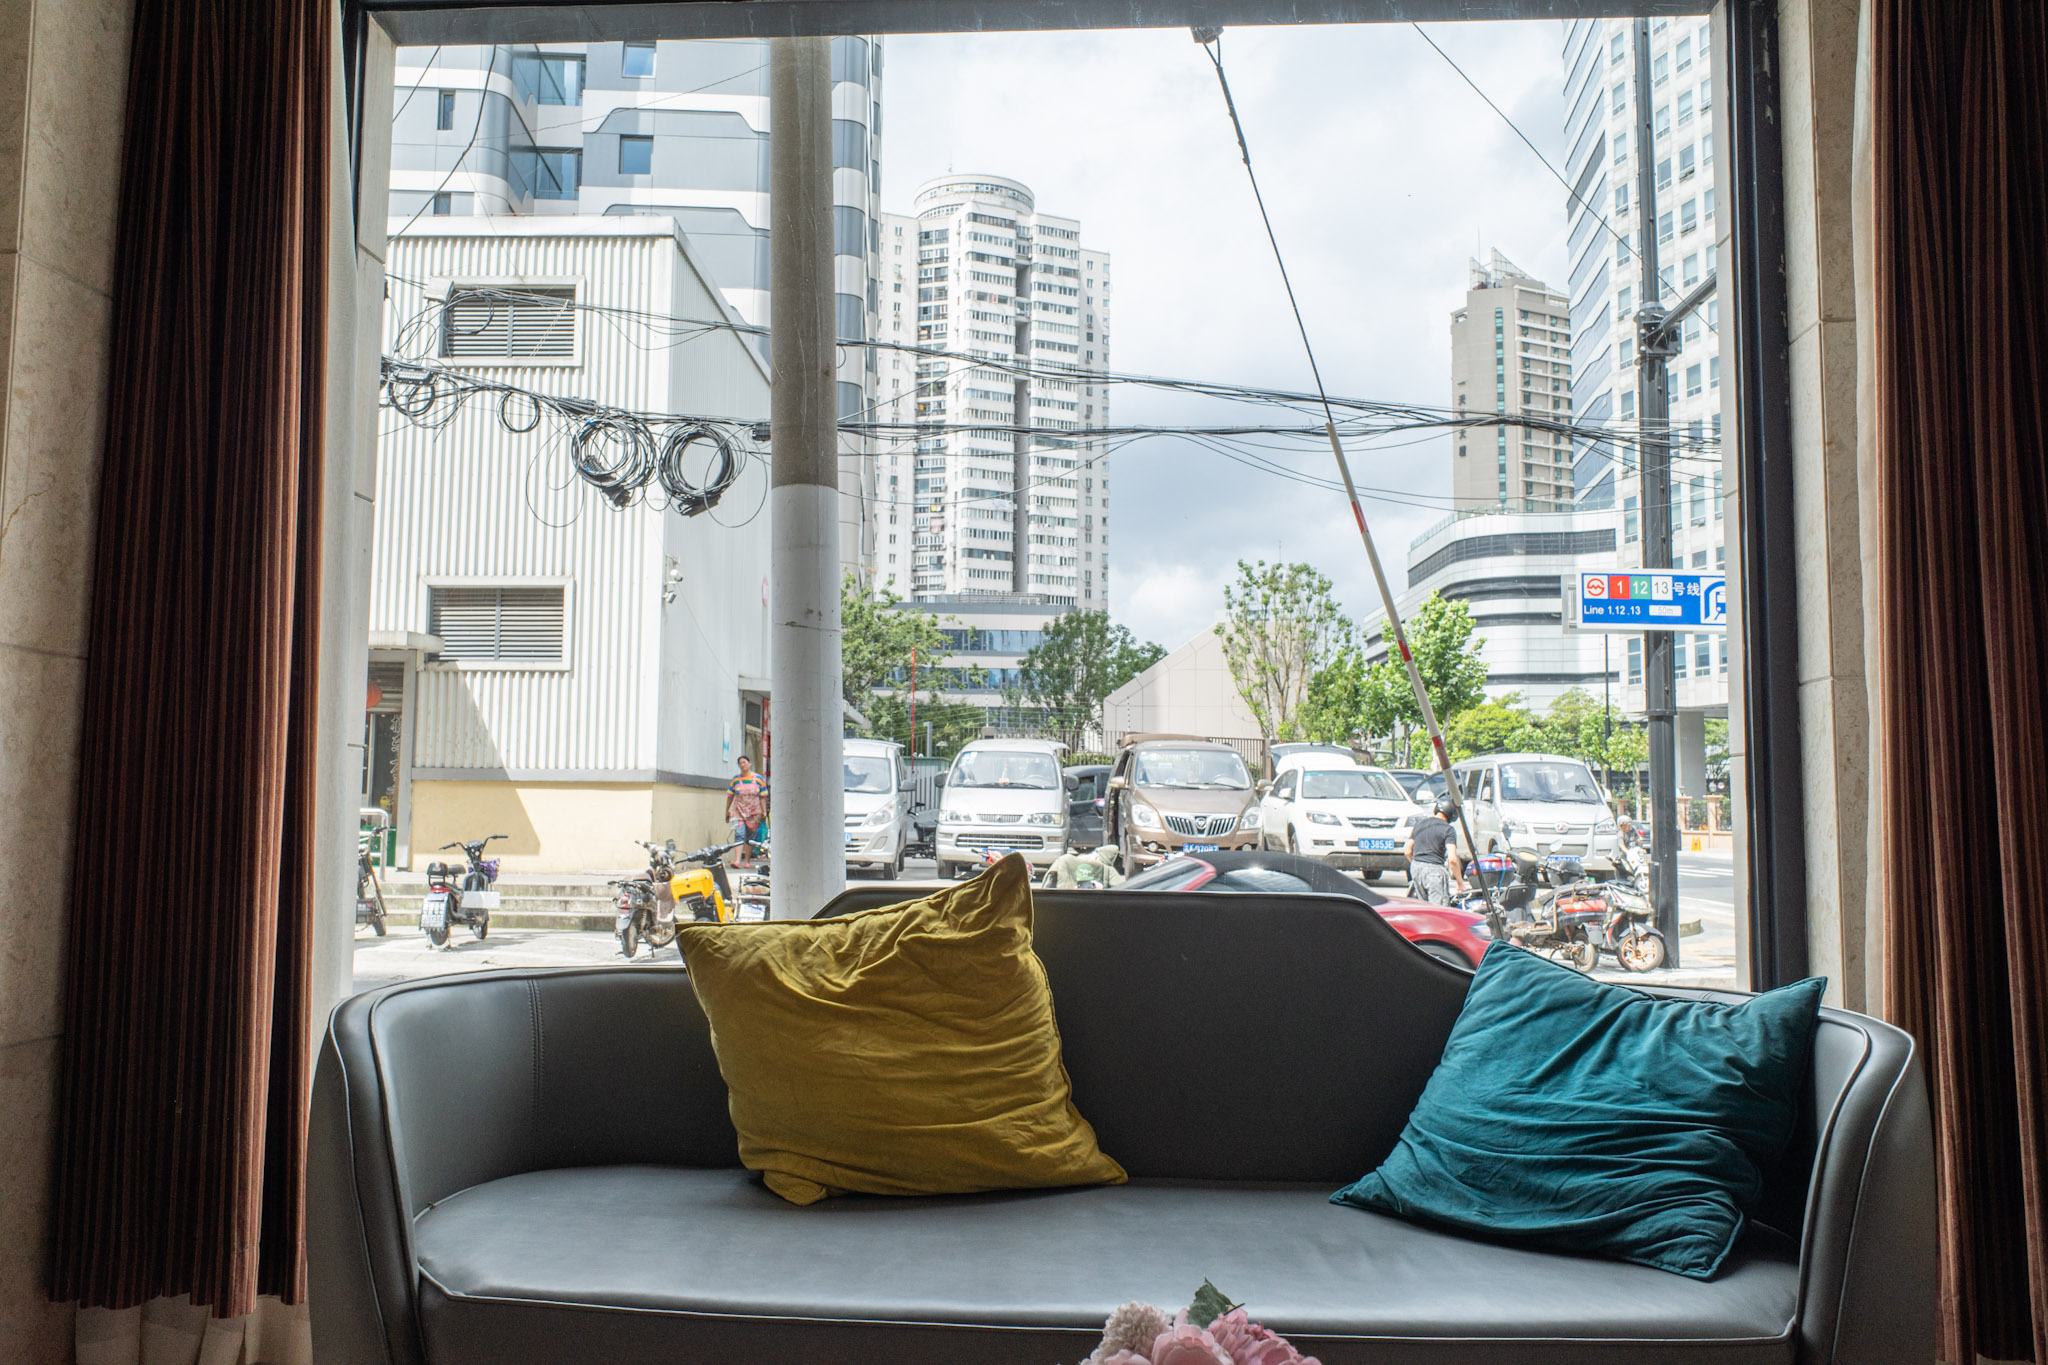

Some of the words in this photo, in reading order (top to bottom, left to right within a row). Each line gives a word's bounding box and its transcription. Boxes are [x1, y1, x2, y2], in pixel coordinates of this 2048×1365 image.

[1617, 580, 1623, 594] 1
[1633, 580, 1648, 594] 12
[1654, 581, 1669, 594] 13
[1672, 581, 1700, 597] 号线
[1584, 605, 1605, 615] Line
[1657, 606, 1674, 615] 50m
